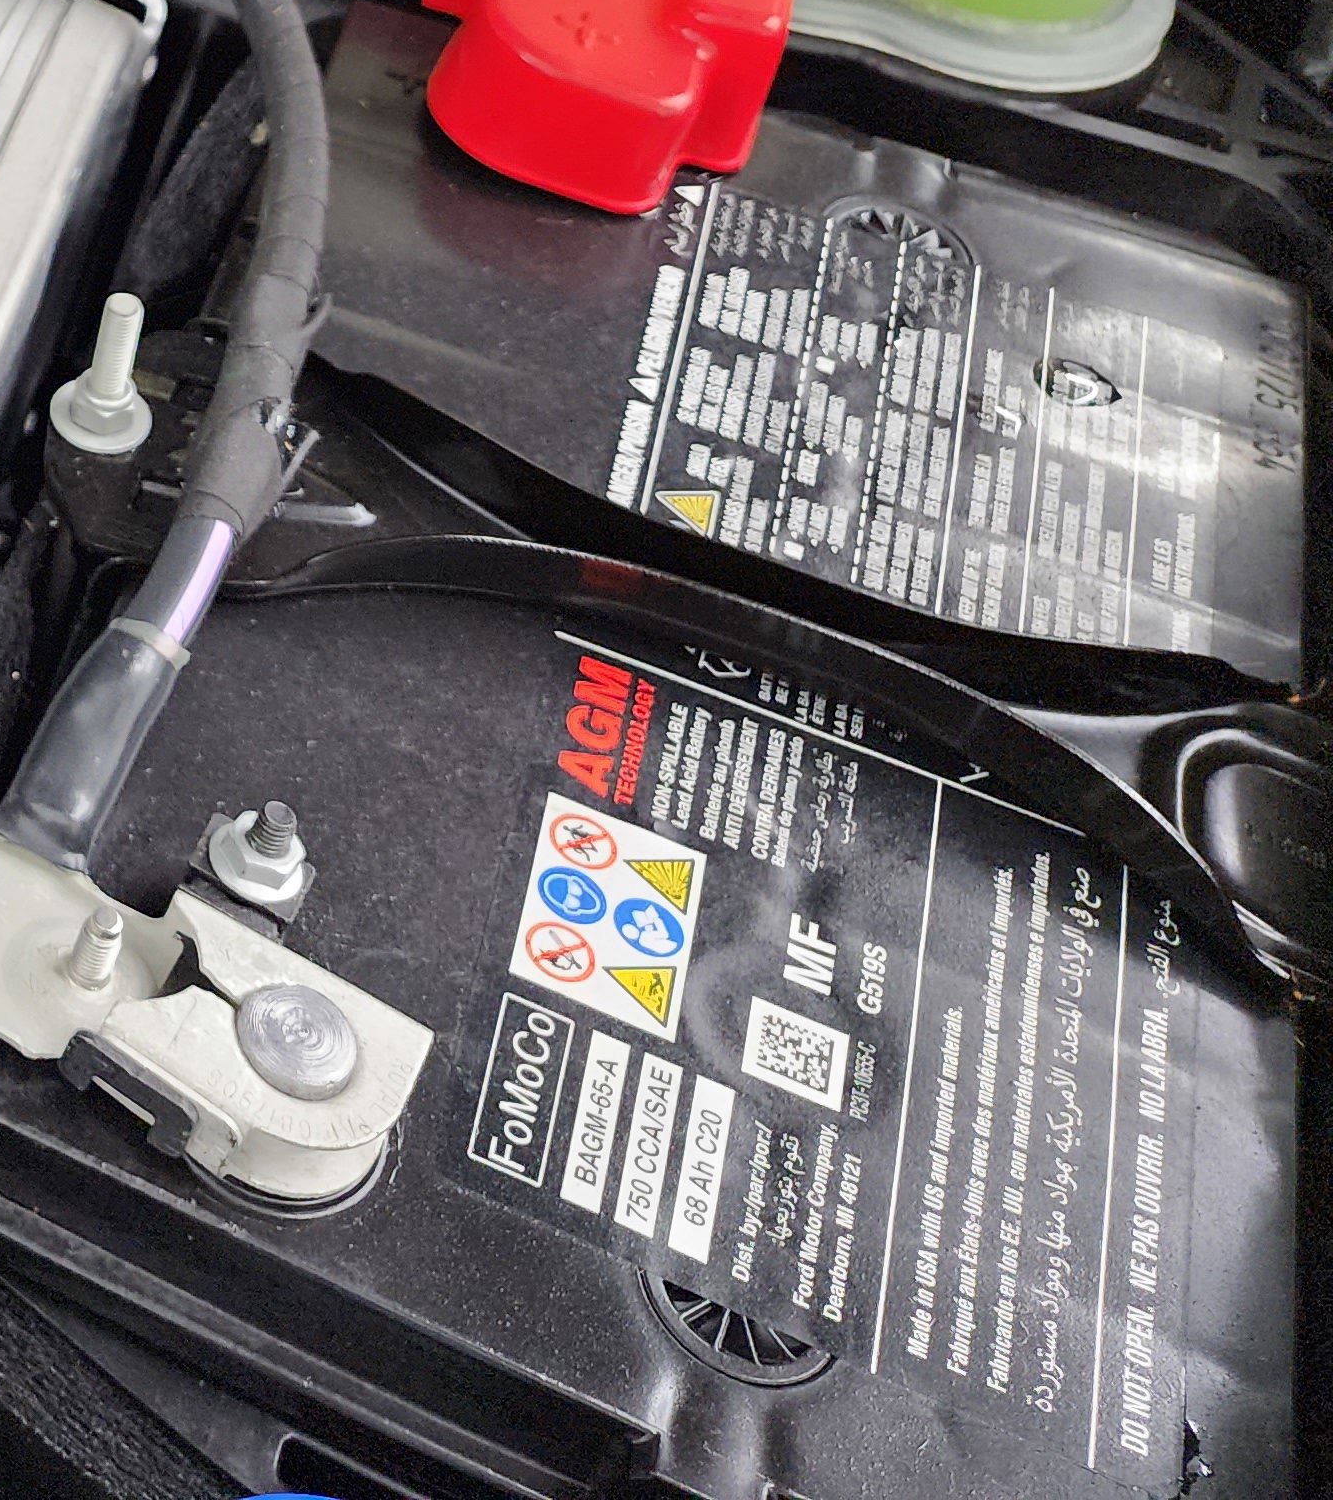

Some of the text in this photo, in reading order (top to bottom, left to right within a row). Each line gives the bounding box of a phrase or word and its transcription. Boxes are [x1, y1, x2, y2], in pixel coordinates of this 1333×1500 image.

[554, 651, 633, 799] AGM
[612, 676, 656, 810] TECHNOLOGY
[650, 699, 689, 822] NON-SPILLABLE
[672, 705, 712, 831] Lead Acid Battery
[698, 715, 738, 842] Batterie au plomb
[722, 713, 759, 850] ANTI DÉVERSEMENT
[750, 798, 775, 862] CONTRA
[988, 860, 1016, 935] importés.
[1026, 846, 1054, 934] importados.
[1061, 900, 1099, 932] في
[1067, 862, 1102, 911] صنع
[782, 909, 838, 999] MF
[855, 937, 888, 1019] G519S
[979, 944, 1007, 1032] américains
[1056, 921, 1094, 1004] الولايات
[1014, 940, 1044, 1068] estadounidenses
[1051, 995, 1084, 1068] المتحدة
[487, 1001, 556, 1177] FoMoCo
[973, 1025, 1000, 1108] matériaux
[1009, 1062, 1035, 1151] materiales
[1040, 1061, 1085, 1159] الأمريكية
[573, 1052, 618, 1188] BAGM-65-A
[625, 1063, 672, 1225] 750 CCA/SAE
[969, 1134, 990, 1180] avec
[971, 1103, 992, 1138] des
[1009, 1146, 1027, 1182] con
[683, 1105, 722, 1229] 68 Ah C20
[906, 999, 963, 1362] Made in USA with US and imported materials.
[1002, 1178, 1024, 1217] UU.
[792, 1115, 841, 1311] Ford Motor Company,
[822, 1149, 862, 1325] Dearborn, MI 48121
[953, 1171, 986, 1266] États-Unis
[999, 1211, 1021, 1247] EE.
[1035, 1201, 1073, 1256] منها
[1119, 997, 1169, 1459] DO NOT OPEN. NE PAS OUVRIR. NO LA ABRA.
[731, 1232, 756, 1285] Dist.
[957, 1261, 977, 1299] aux
[997, 1242, 1018, 1275] los
[998, 1272, 1016, 1299] en
[1029, 1245, 1071, 1319] ومواد
[946, 1293, 977, 1380] Fabriqué
[1024, 1310, 1067, 1420] مستوردة
